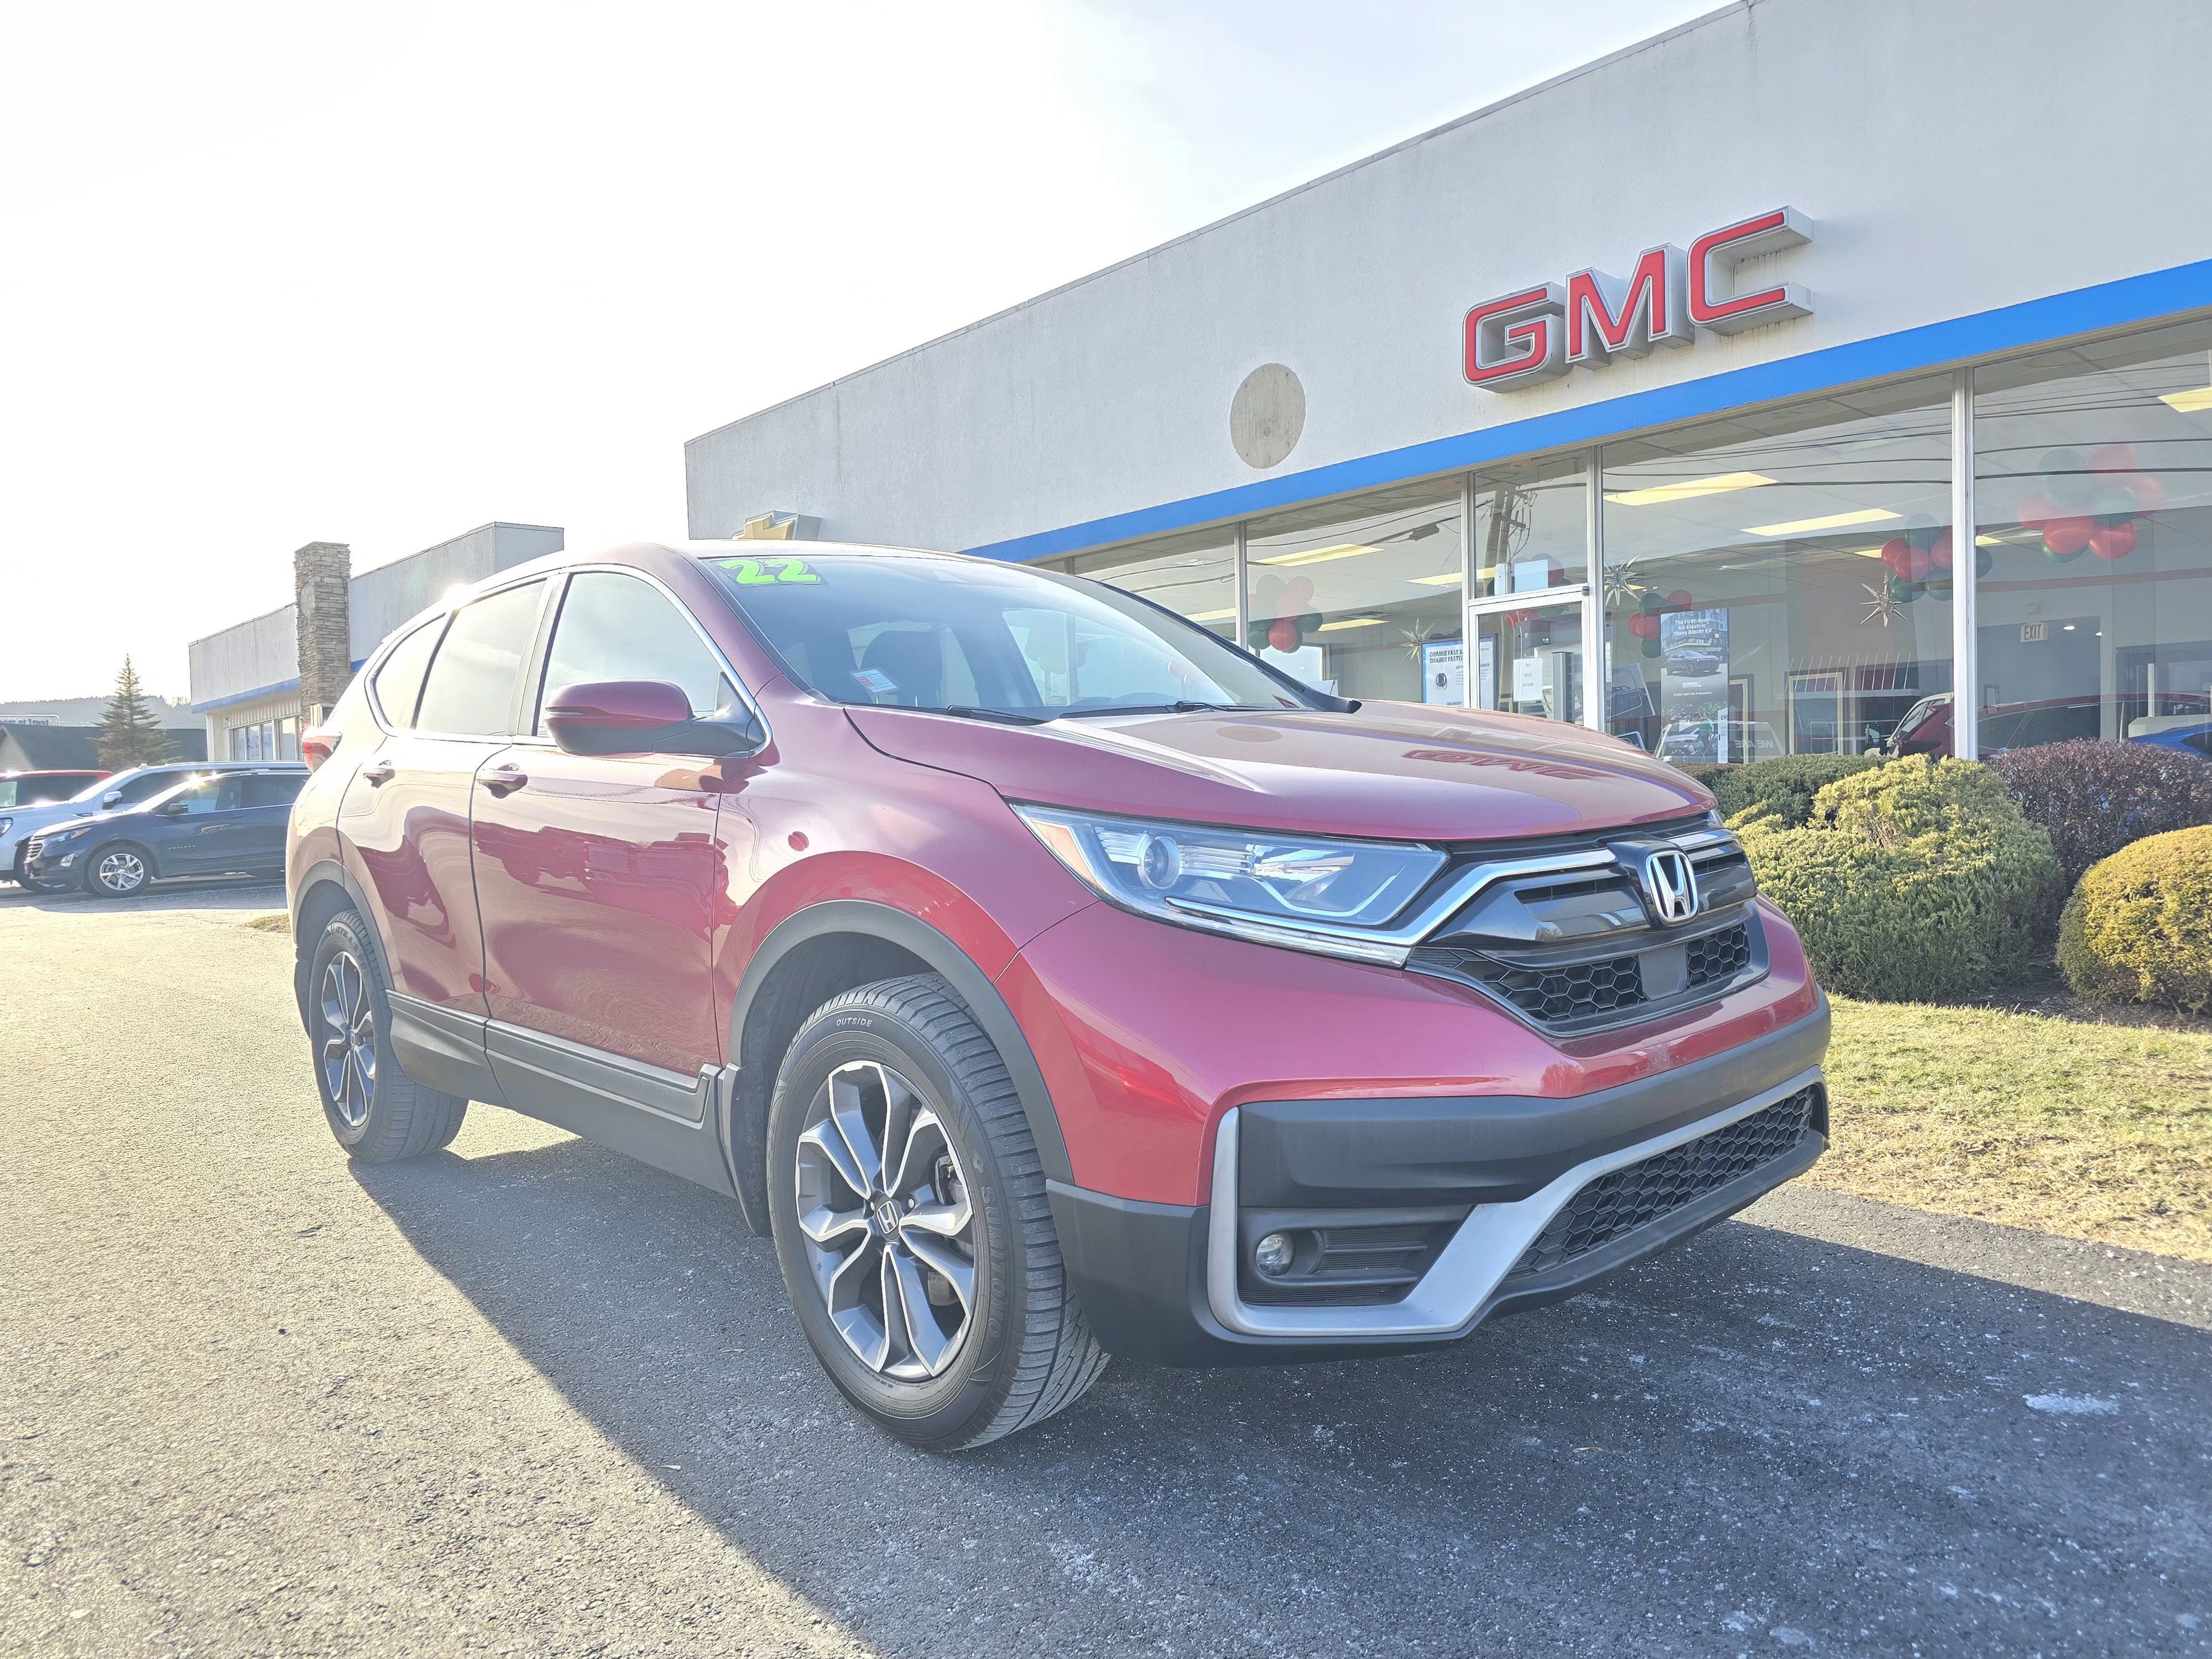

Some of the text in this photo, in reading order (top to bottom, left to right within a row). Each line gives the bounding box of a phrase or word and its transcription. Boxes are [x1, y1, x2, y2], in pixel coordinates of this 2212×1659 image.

[1462, 205, 1814, 393] GMC
[719, 559, 821, 585] 22
[2024, 624, 2042, 640] EXIT
[836, 1017, 873, 1027] OUTSIDE
[980, 1186, 1007, 1338] SUMITOMO
